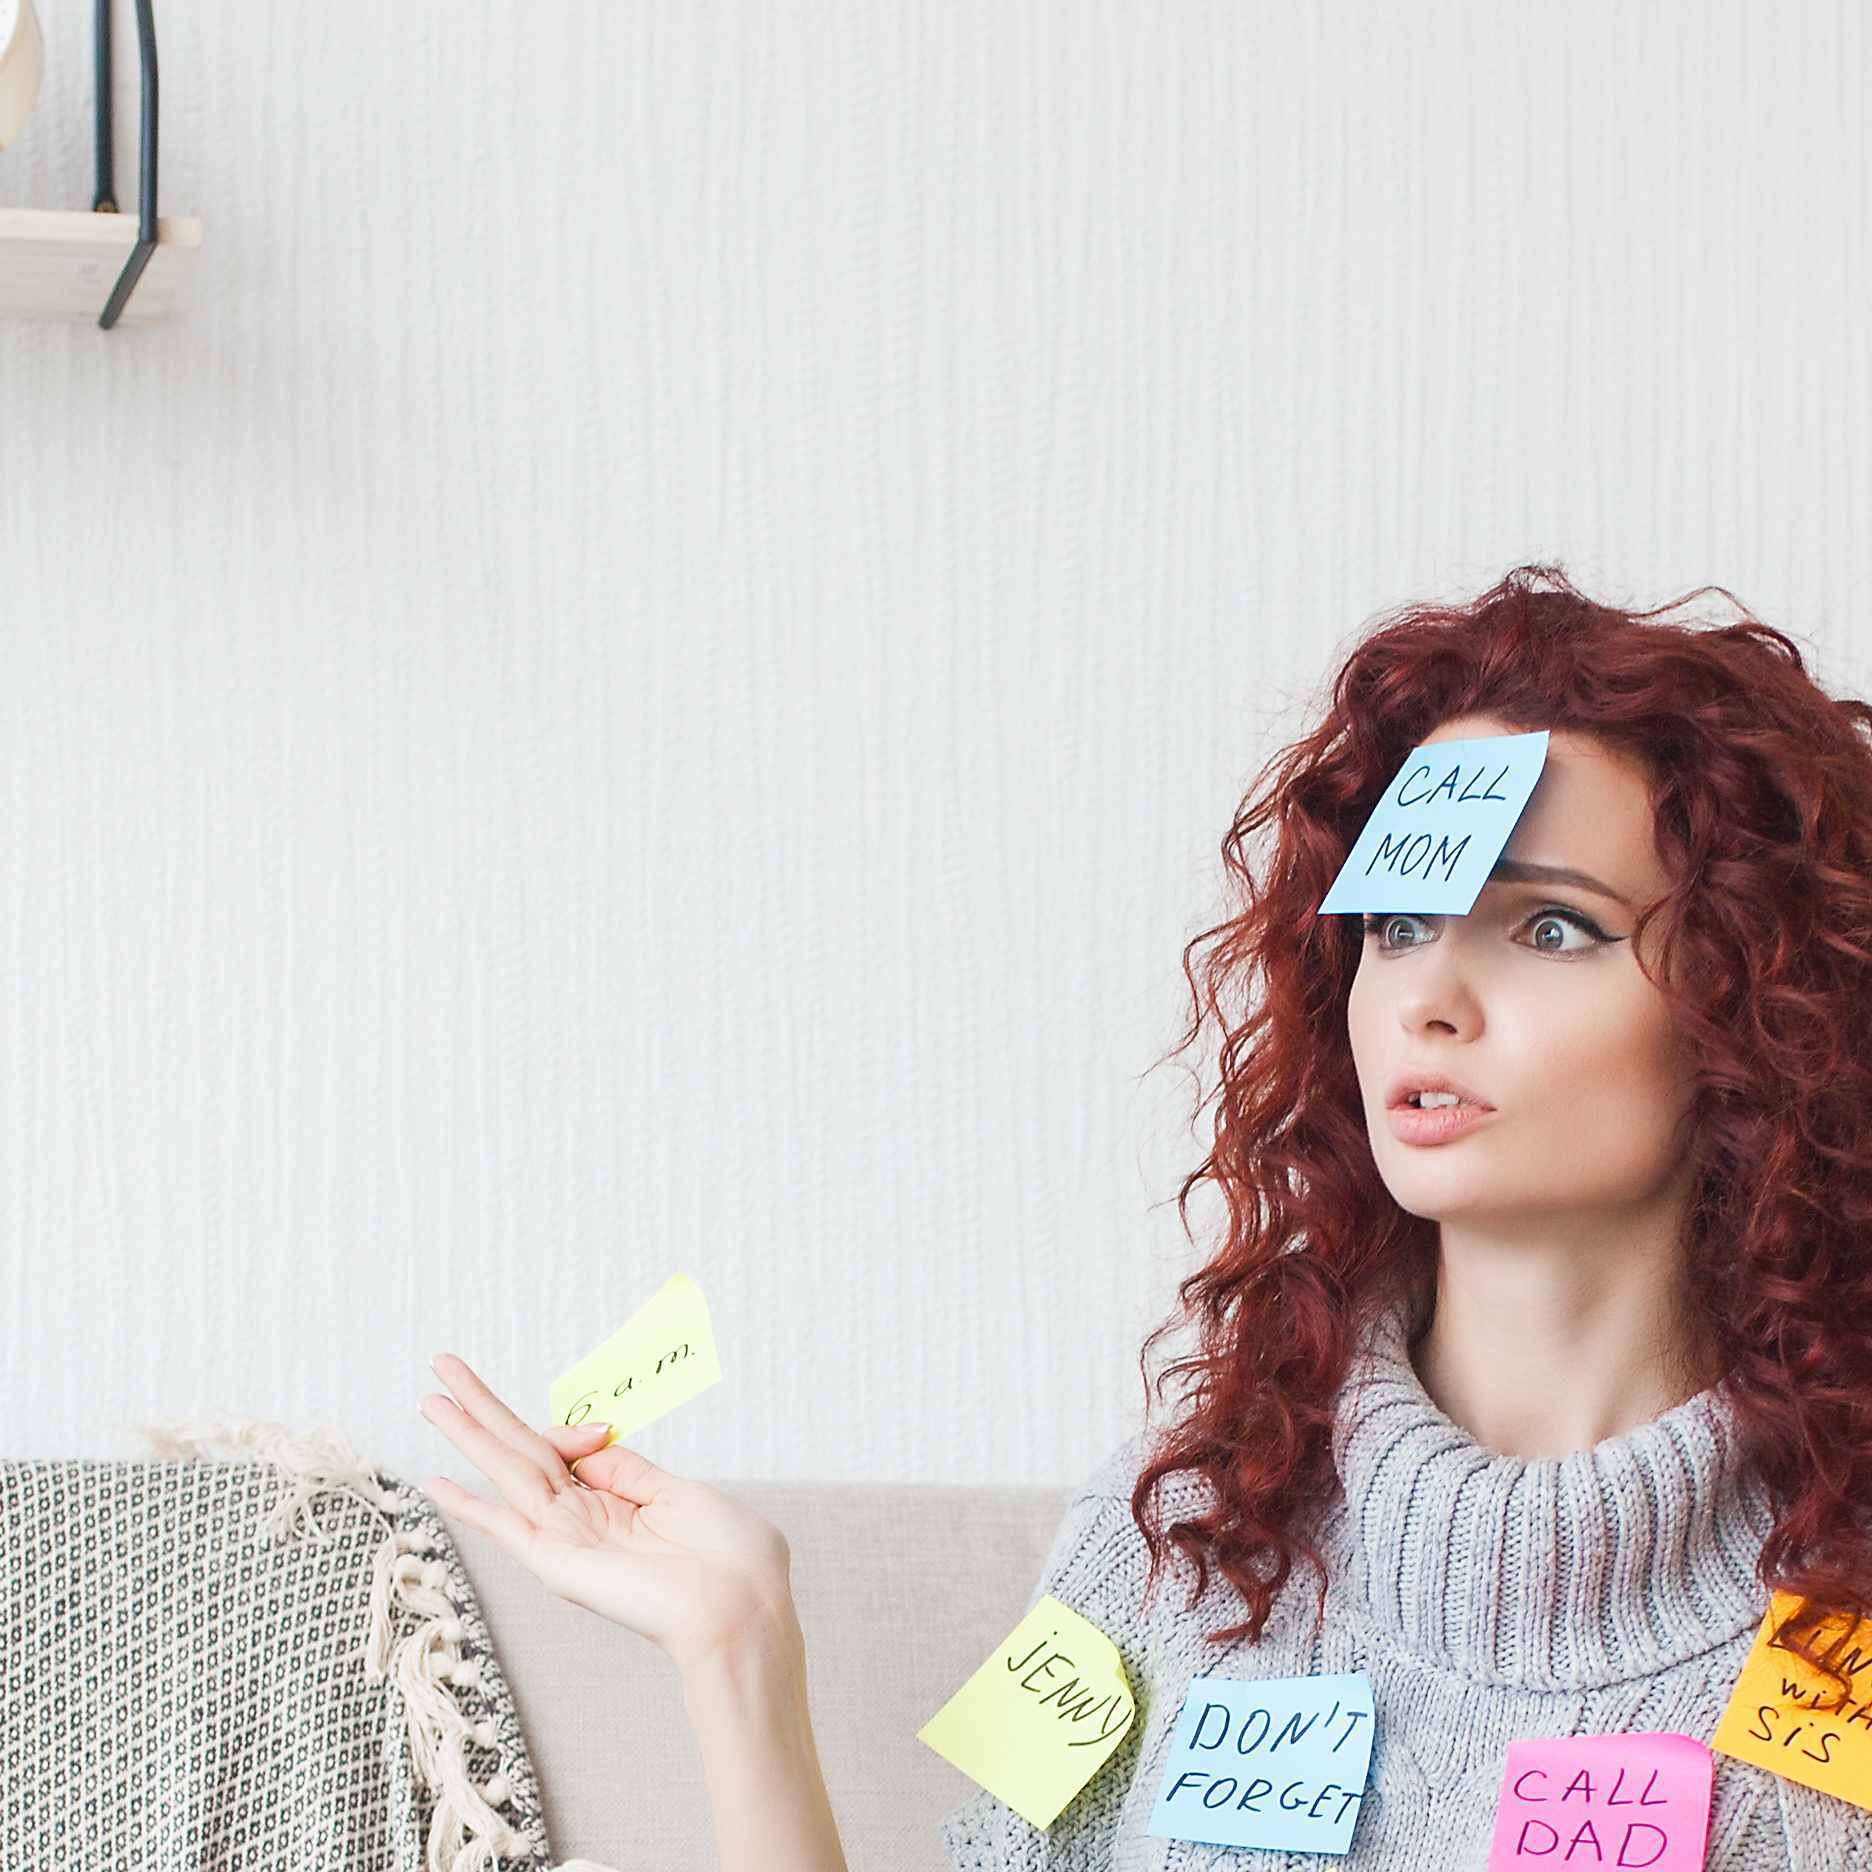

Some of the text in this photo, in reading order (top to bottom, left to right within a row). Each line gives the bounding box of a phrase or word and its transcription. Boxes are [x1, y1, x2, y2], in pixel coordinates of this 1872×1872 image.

[1397, 765, 1510, 806] CALL
[1366, 833, 1471, 881] MOM
[1188, 1700, 1368, 1753] DON'T
[1165, 1771, 1363, 1825] FORGET
[1513, 1768, 1668, 1807] CALL
[1516, 1820, 1668, 1868] DAD
